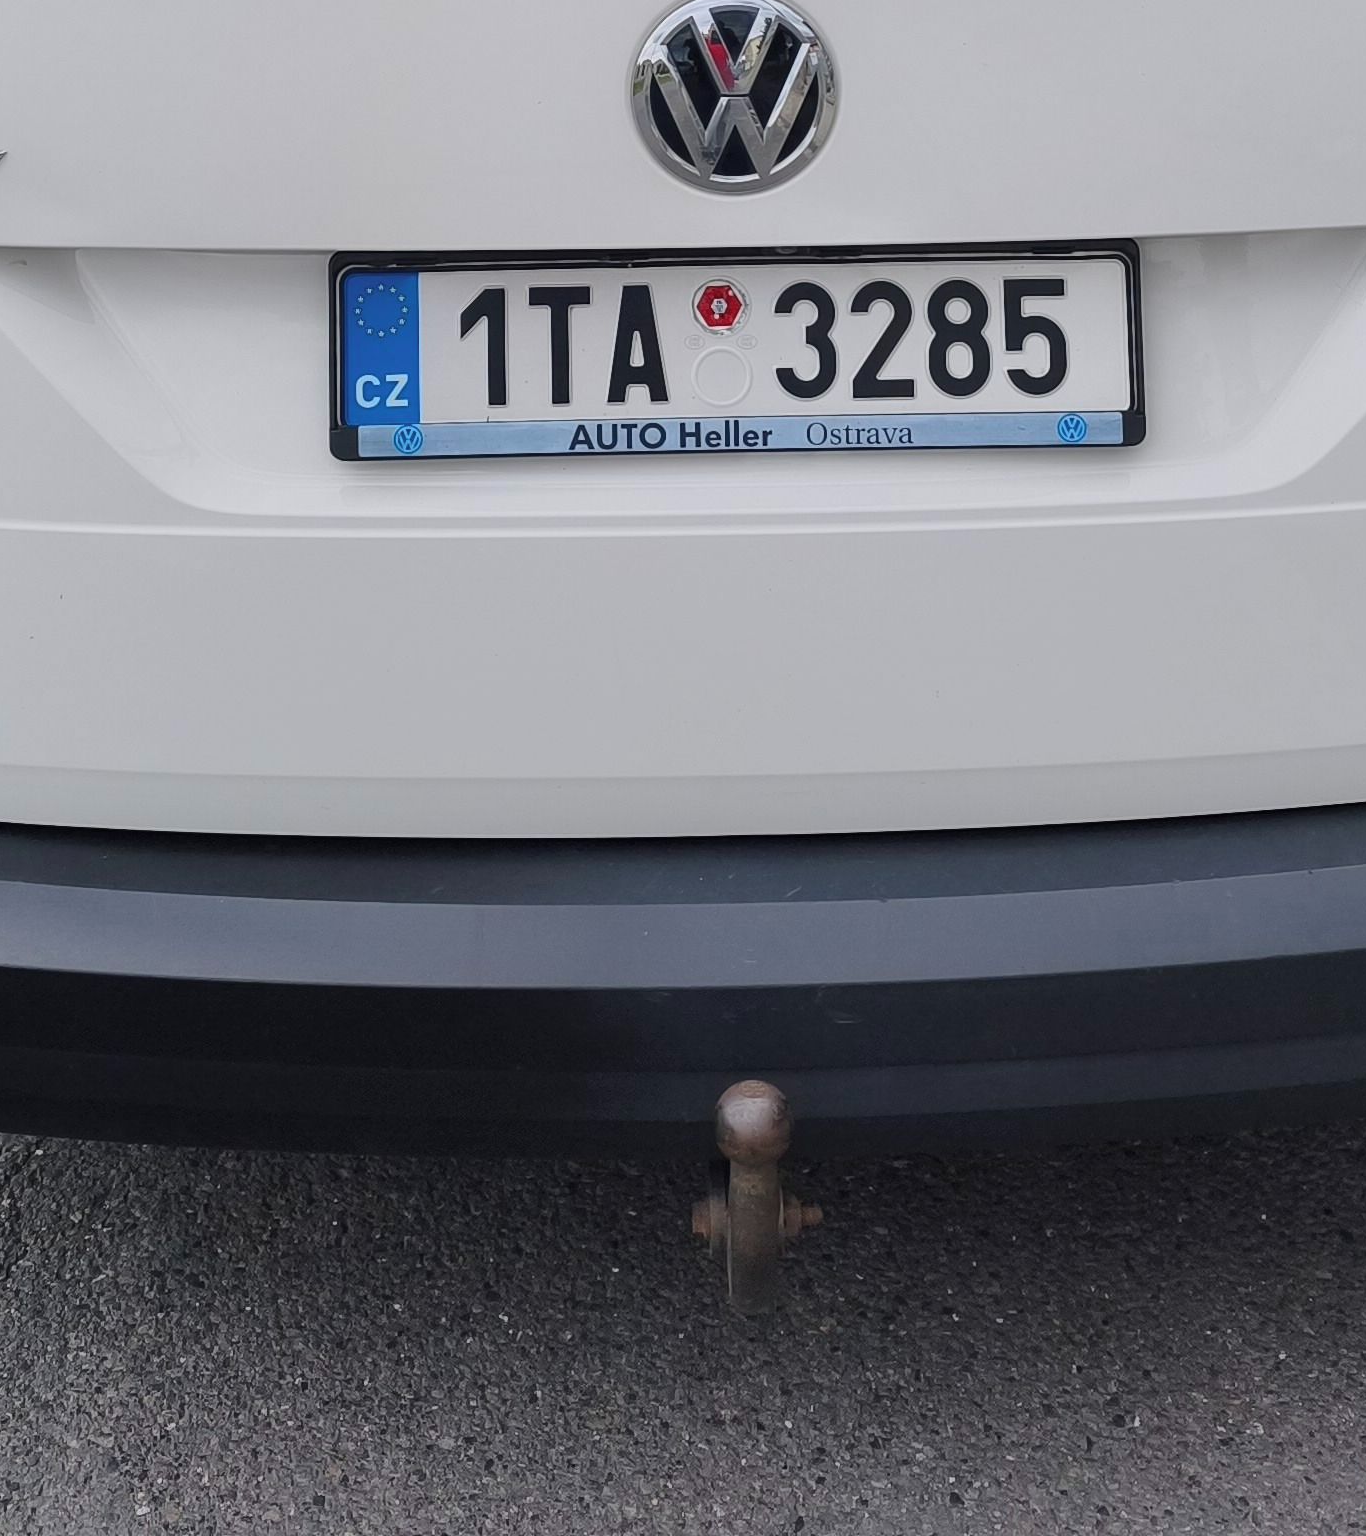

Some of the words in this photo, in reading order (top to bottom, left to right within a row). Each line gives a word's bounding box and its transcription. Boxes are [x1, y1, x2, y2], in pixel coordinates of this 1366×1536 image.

[459, 284, 670, 406] 1TA
[773, 278, 1068, 399] 3285
[355, 373, 409, 409] CZ
[568, 422, 667, 451] AUTO
[679, 419, 773, 448] Heller
[806, 421, 915, 446] Ostrava
